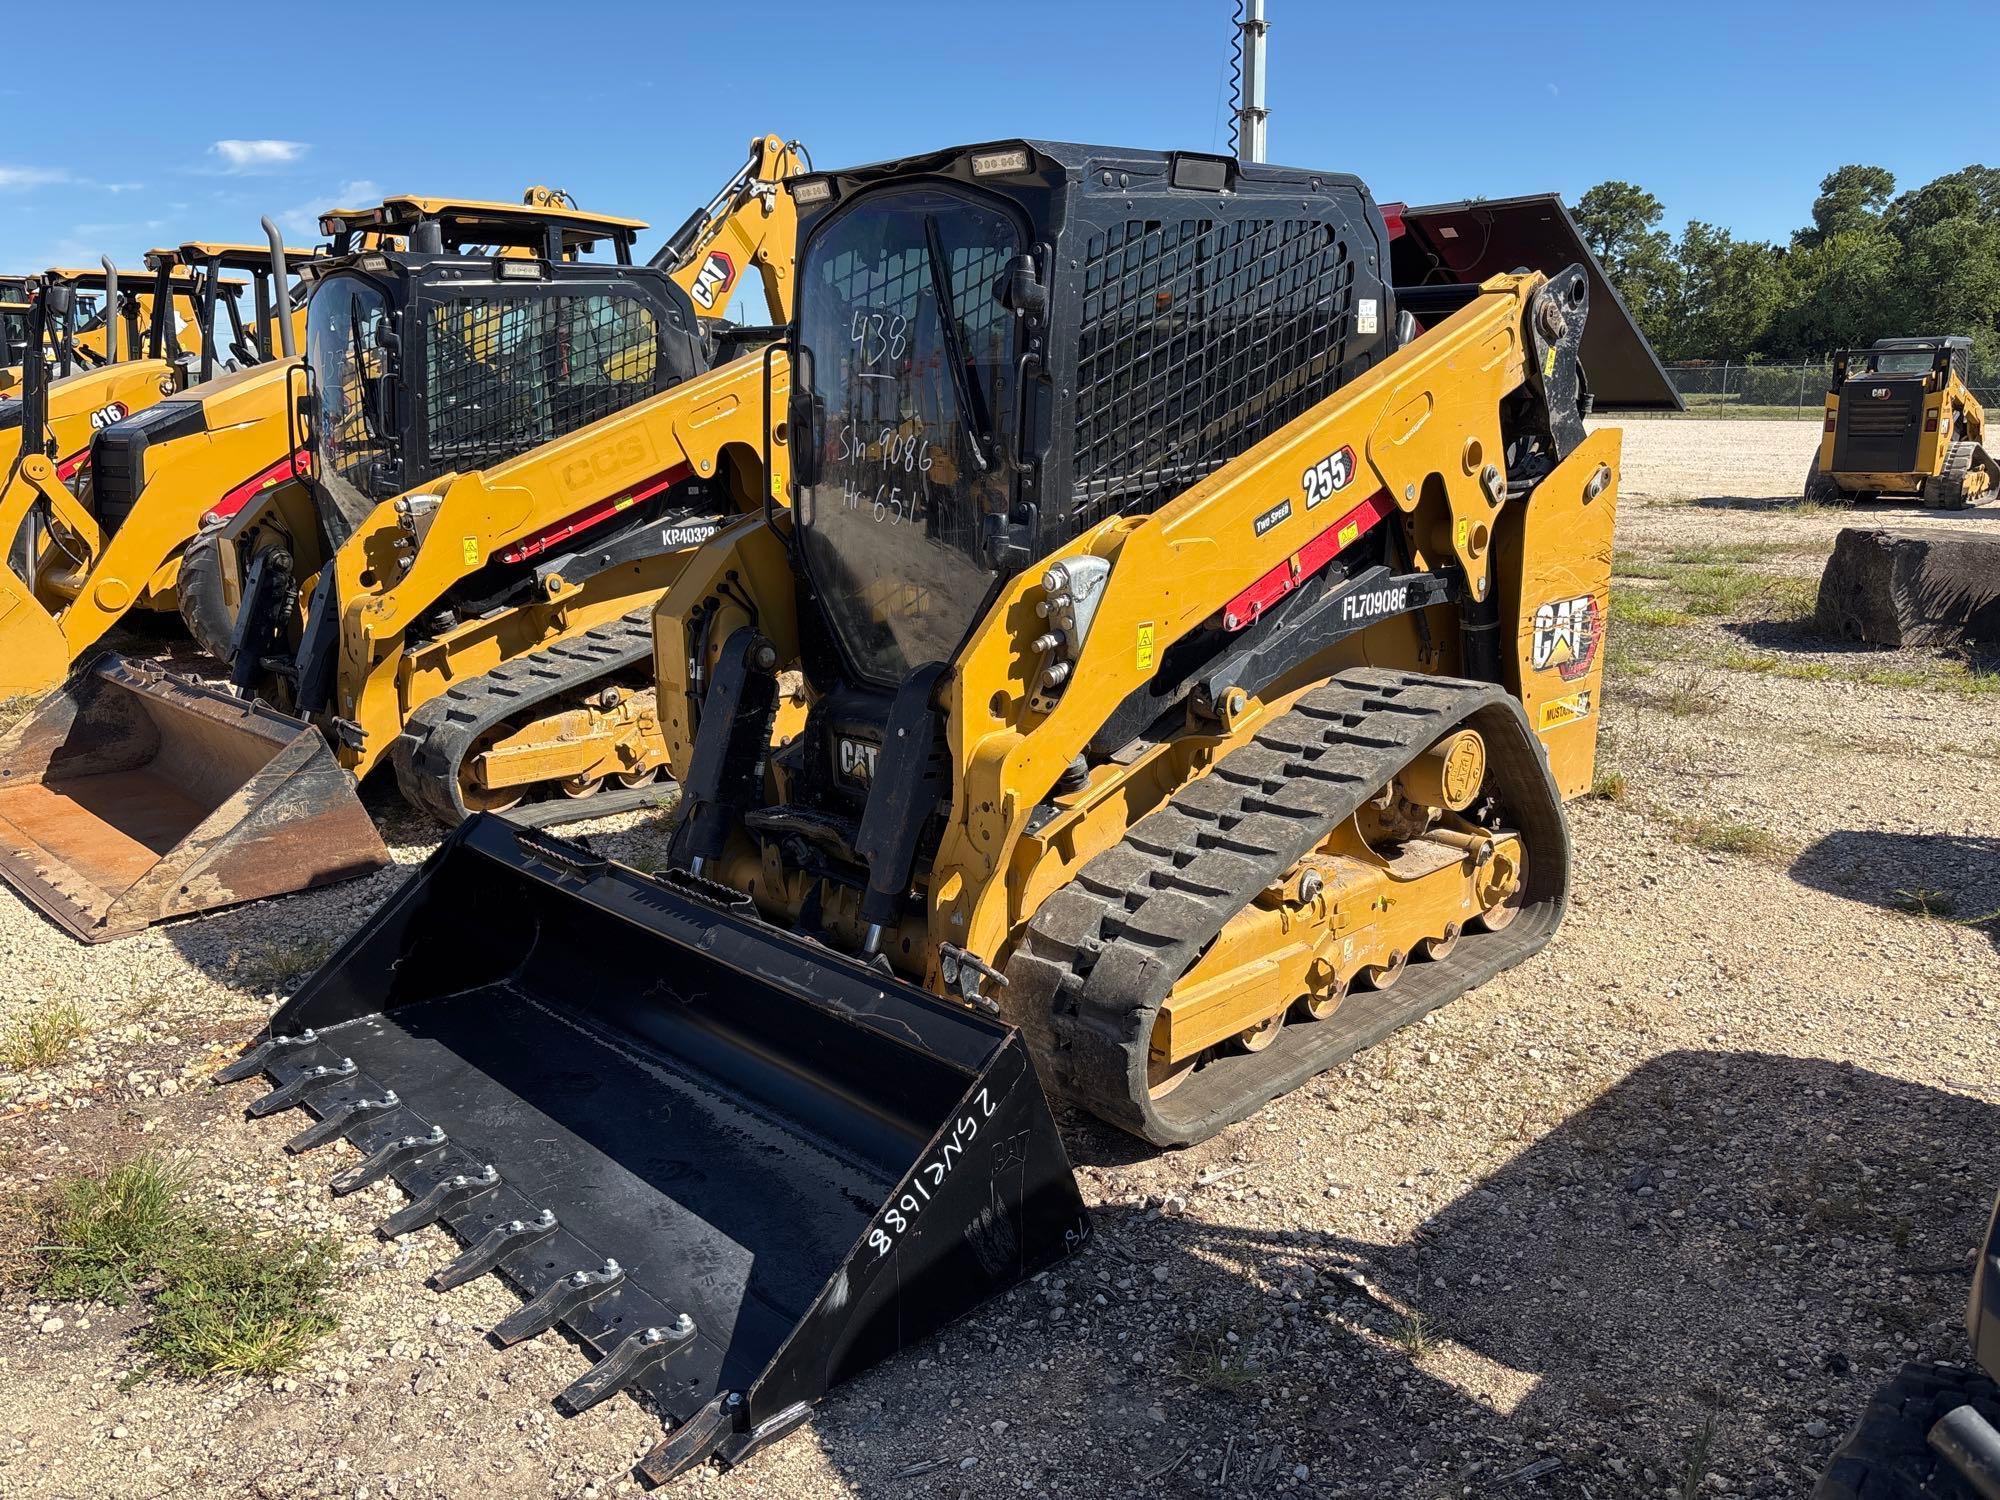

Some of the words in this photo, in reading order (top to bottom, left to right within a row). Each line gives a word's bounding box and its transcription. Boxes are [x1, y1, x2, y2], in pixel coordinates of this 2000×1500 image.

[691, 255, 728, 309] CAT
[851, 310, 907, 367] 438
[1871, 388, 1887, 397] CAT
[91, 404, 122, 428] 416
[878, 427, 933, 473] 9086
[1303, 450, 1346, 509] 255
[872, 483, 917, 527] 651
[1342, 585, 1408, 621] FL709086
[1533, 596, 1589, 669] CAT
[841, 740, 878, 779] CAT
